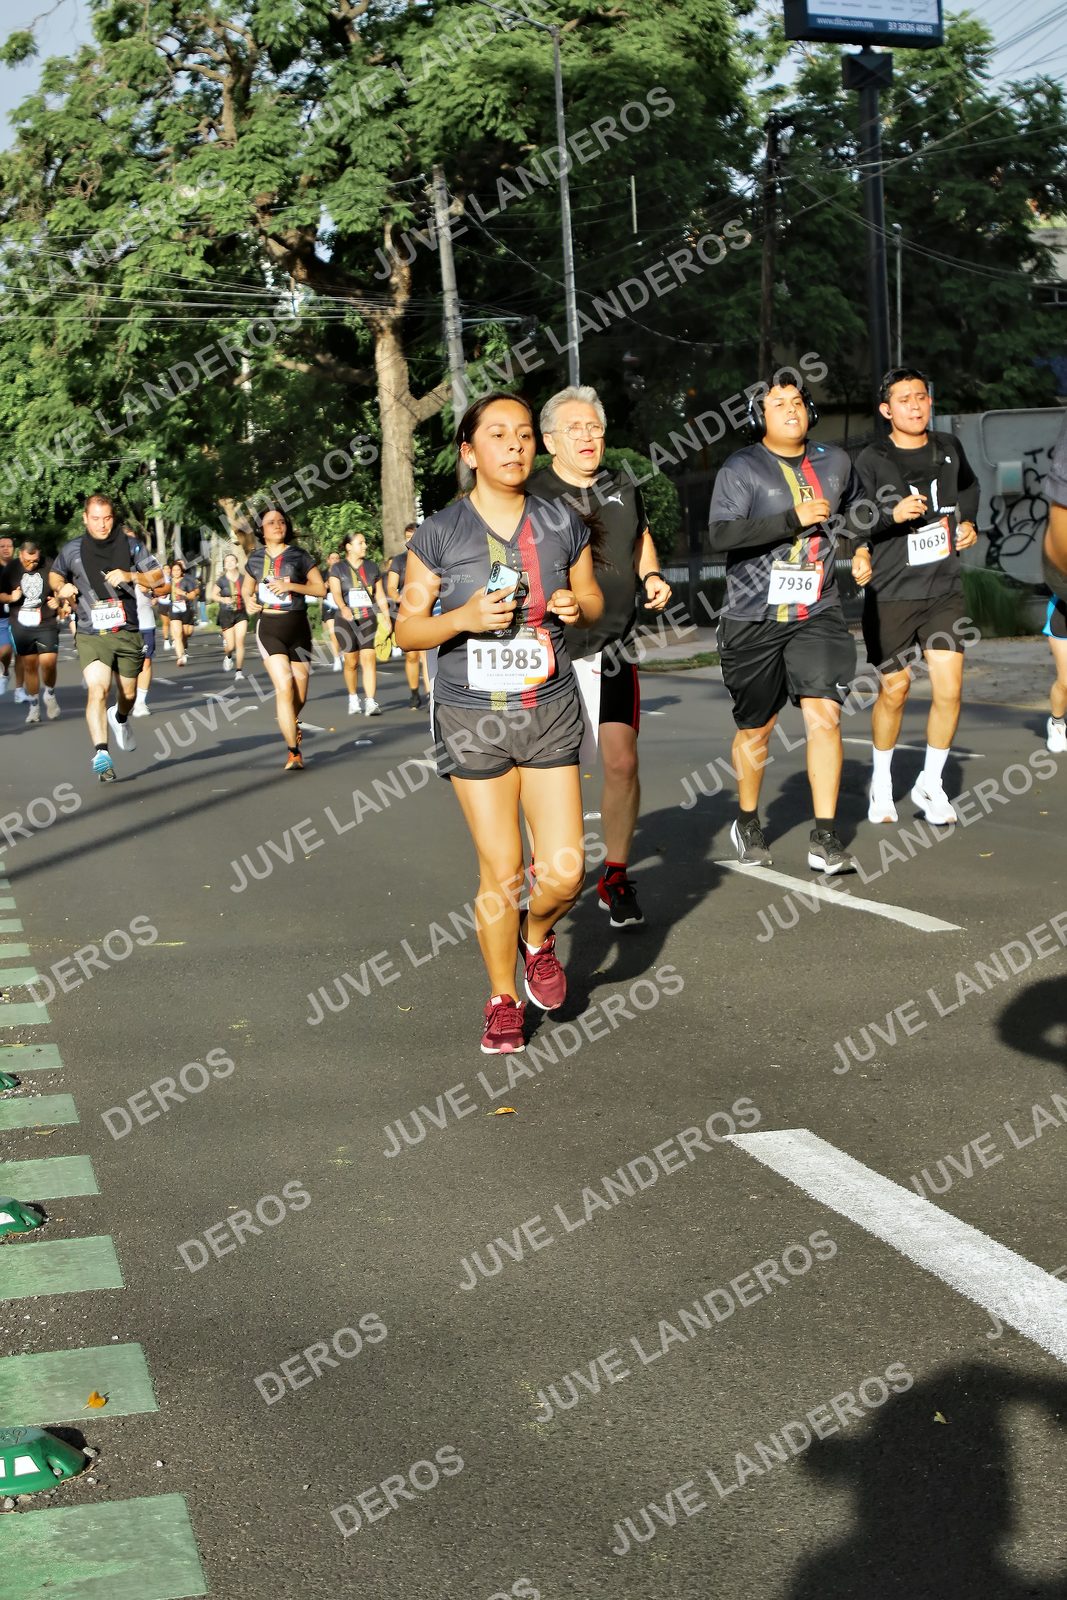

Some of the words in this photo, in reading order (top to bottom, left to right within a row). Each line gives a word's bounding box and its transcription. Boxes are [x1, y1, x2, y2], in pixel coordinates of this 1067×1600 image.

[911, 532, 946, 551] 10639
[779, 576, 812, 590] 7936
[472, 648, 542, 670] 11985
